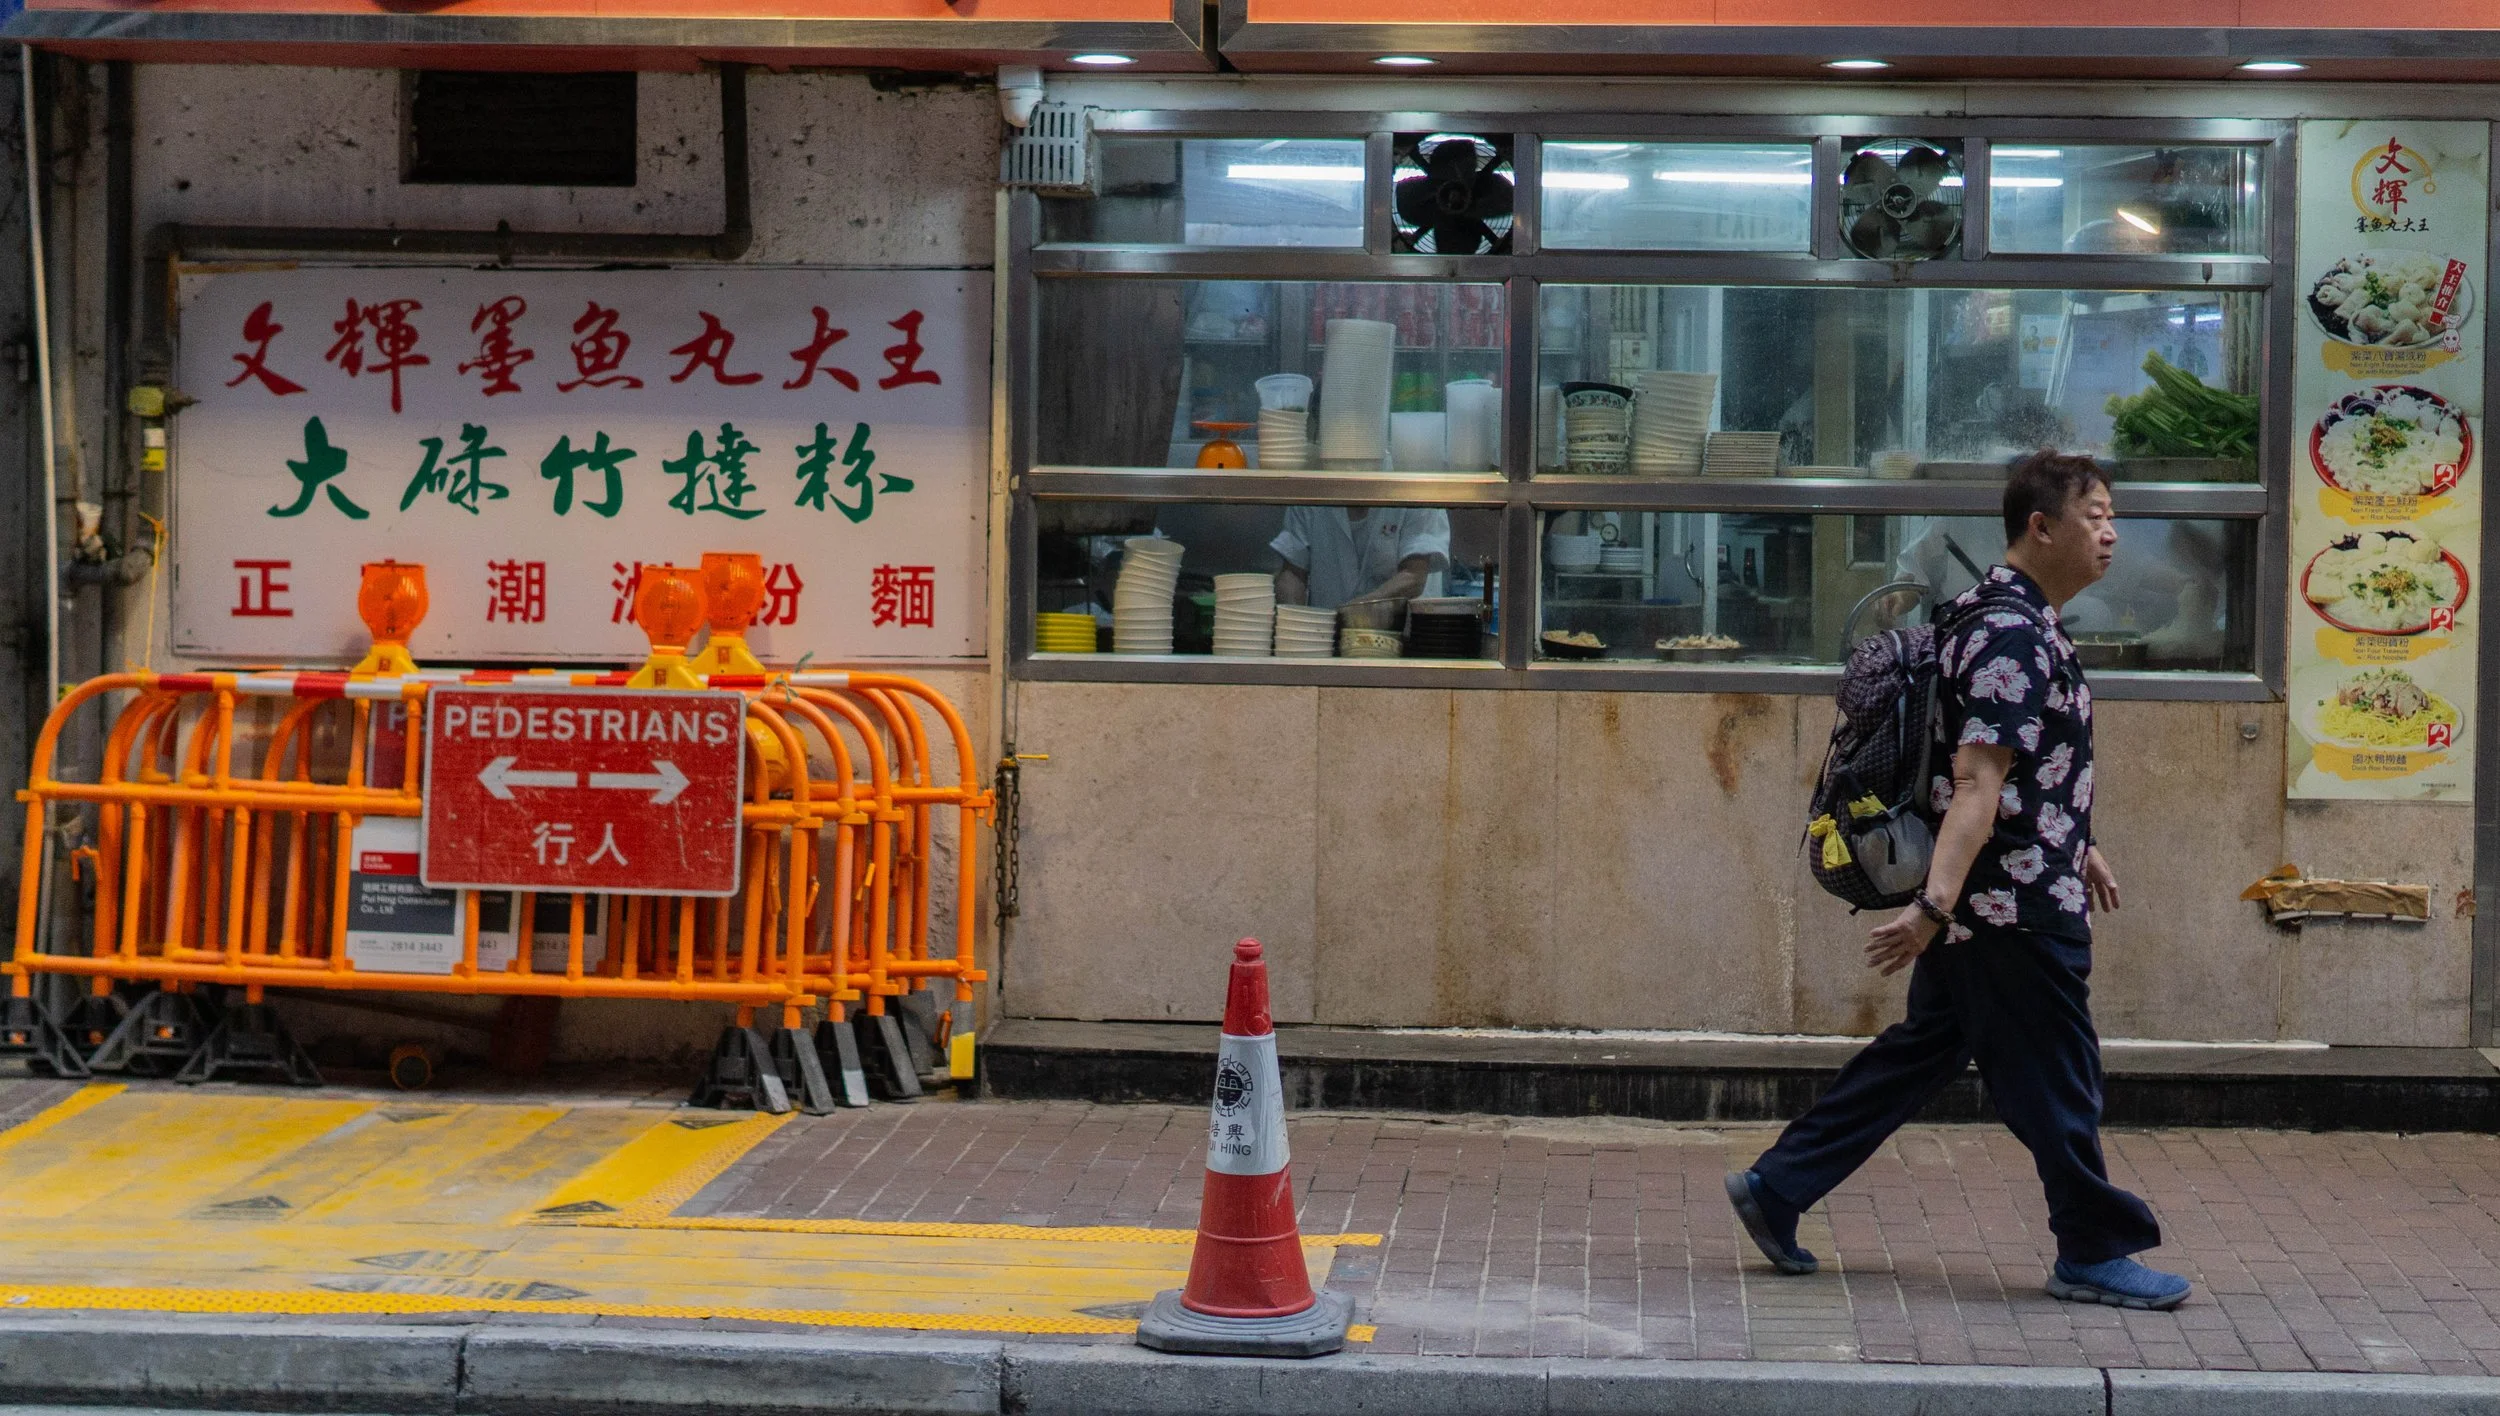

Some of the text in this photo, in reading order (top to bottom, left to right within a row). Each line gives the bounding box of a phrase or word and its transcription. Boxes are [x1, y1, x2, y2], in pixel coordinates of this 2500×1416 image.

[2371, 136, 2412, 215] 文輝
[2354, 216, 2430, 233] 墨魚丸大王
[226, 295, 942, 412] 文輝墨魚丸大王
[444, 705, 729, 744] PEDESTRIANS
[531, 821, 630, 867] 行人
[1220, 1143, 1252, 1156] HING
